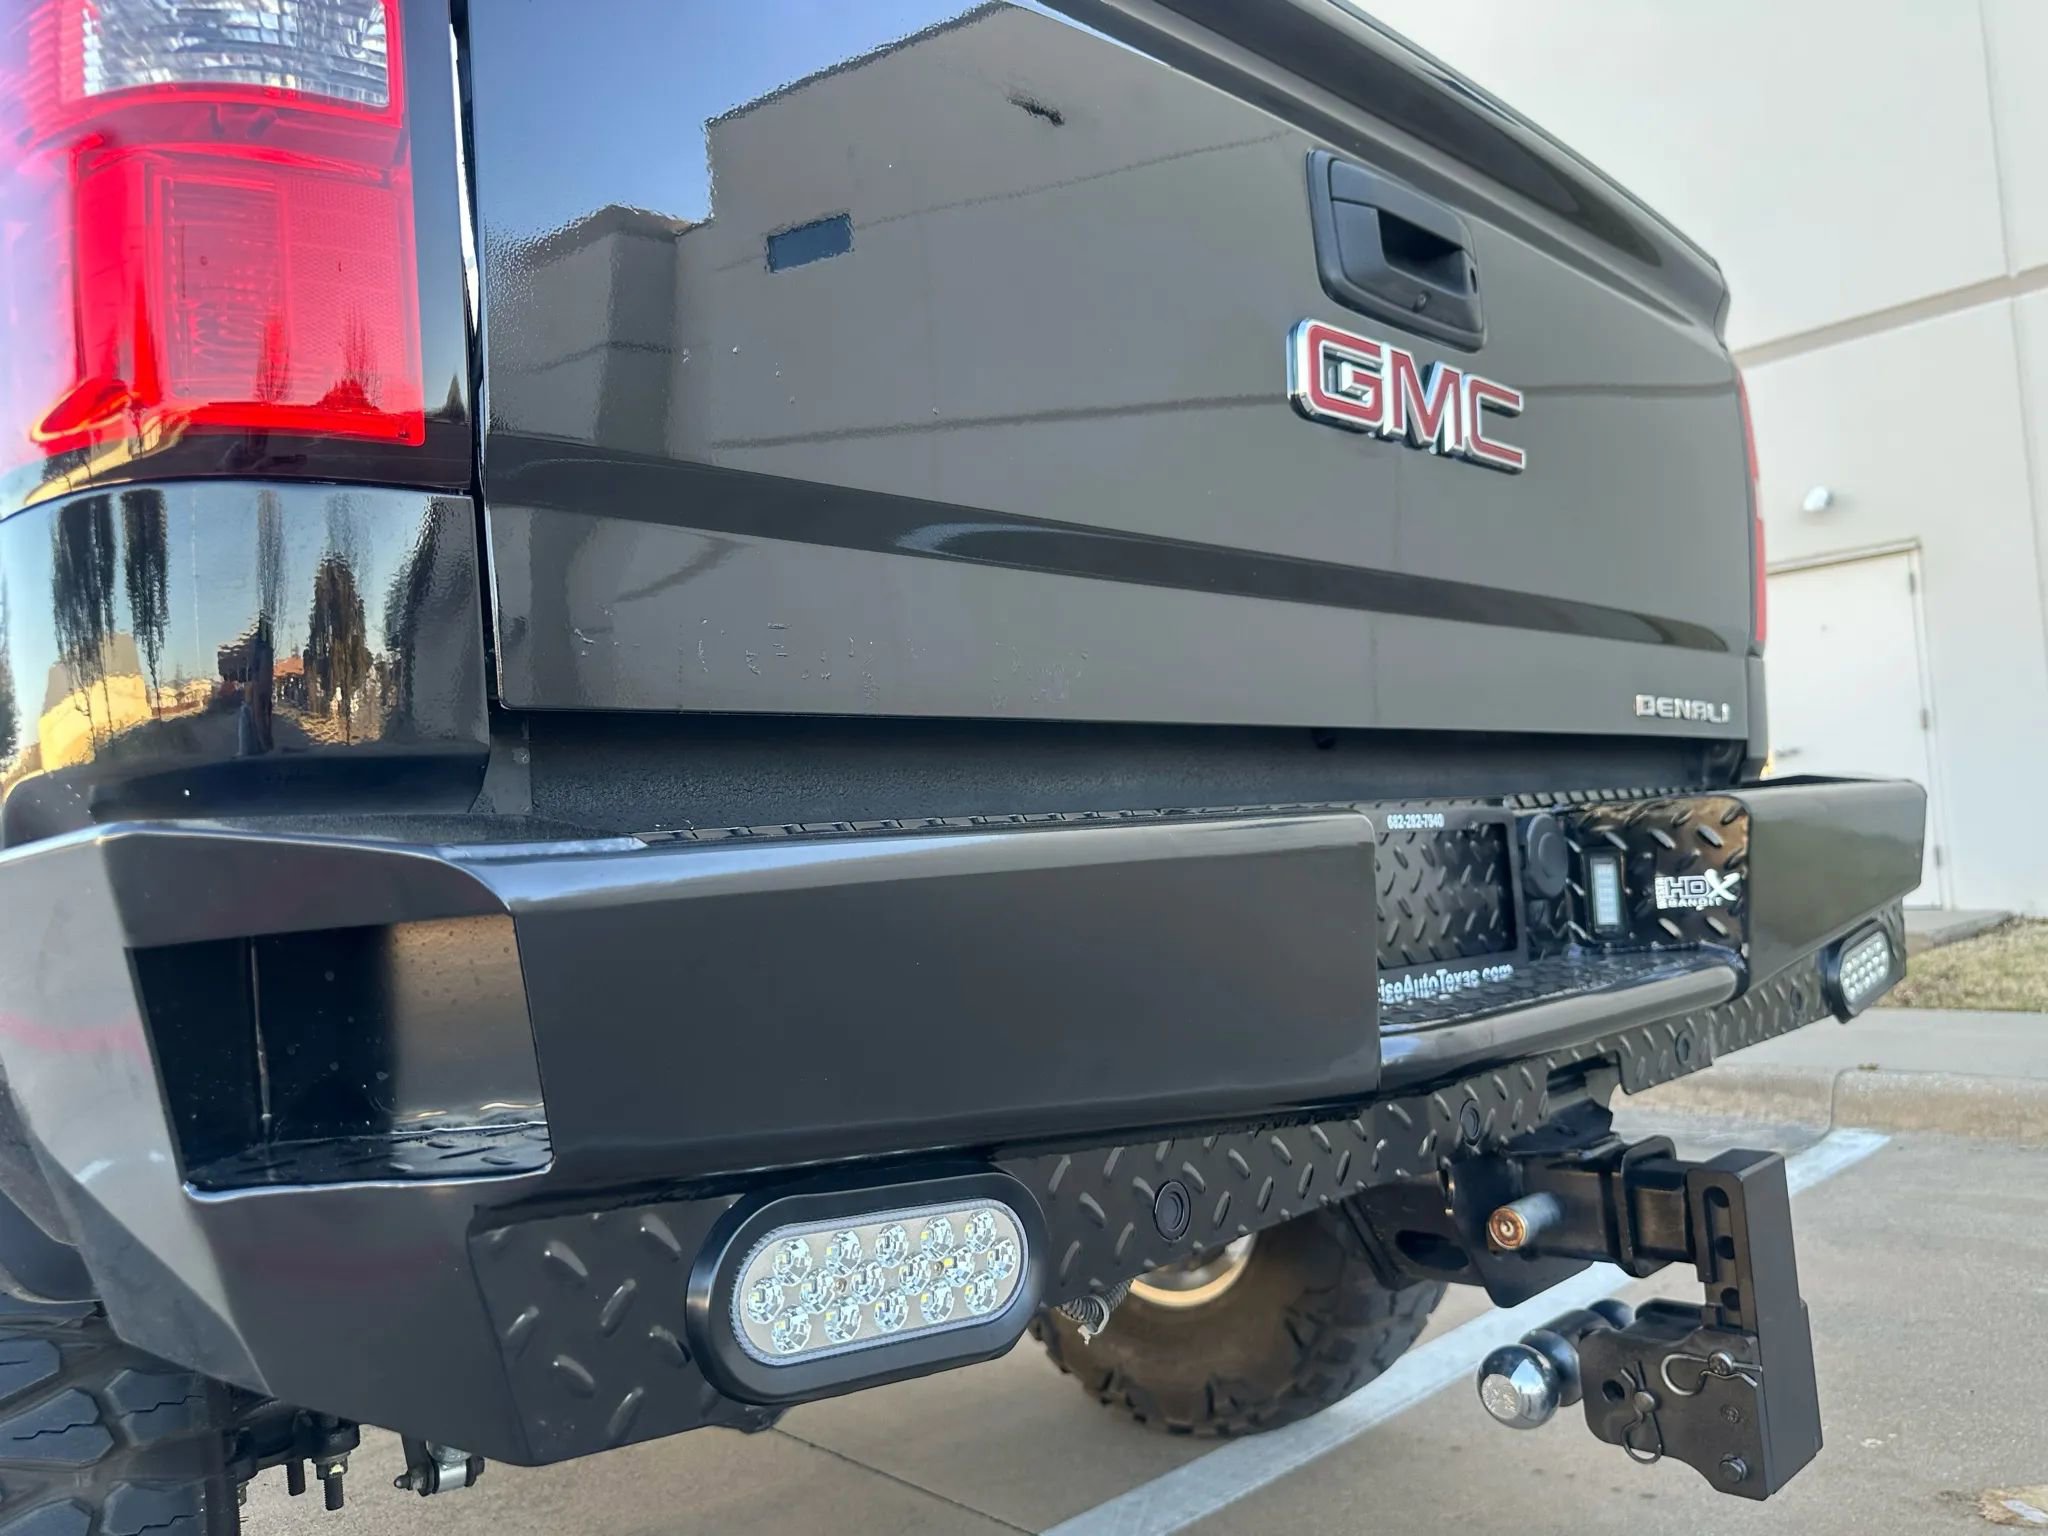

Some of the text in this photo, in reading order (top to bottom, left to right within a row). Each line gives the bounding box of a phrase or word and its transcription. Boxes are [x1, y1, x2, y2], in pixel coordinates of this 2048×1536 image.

[1287, 319, 1526, 471] GMC
[1635, 694, 1730, 723] DENALI
[1664, 868, 1741, 901] HDX
[1667, 897, 1723, 908] BANDIT
[1377, 963, 1514, 998] iseAutoTexas.com
